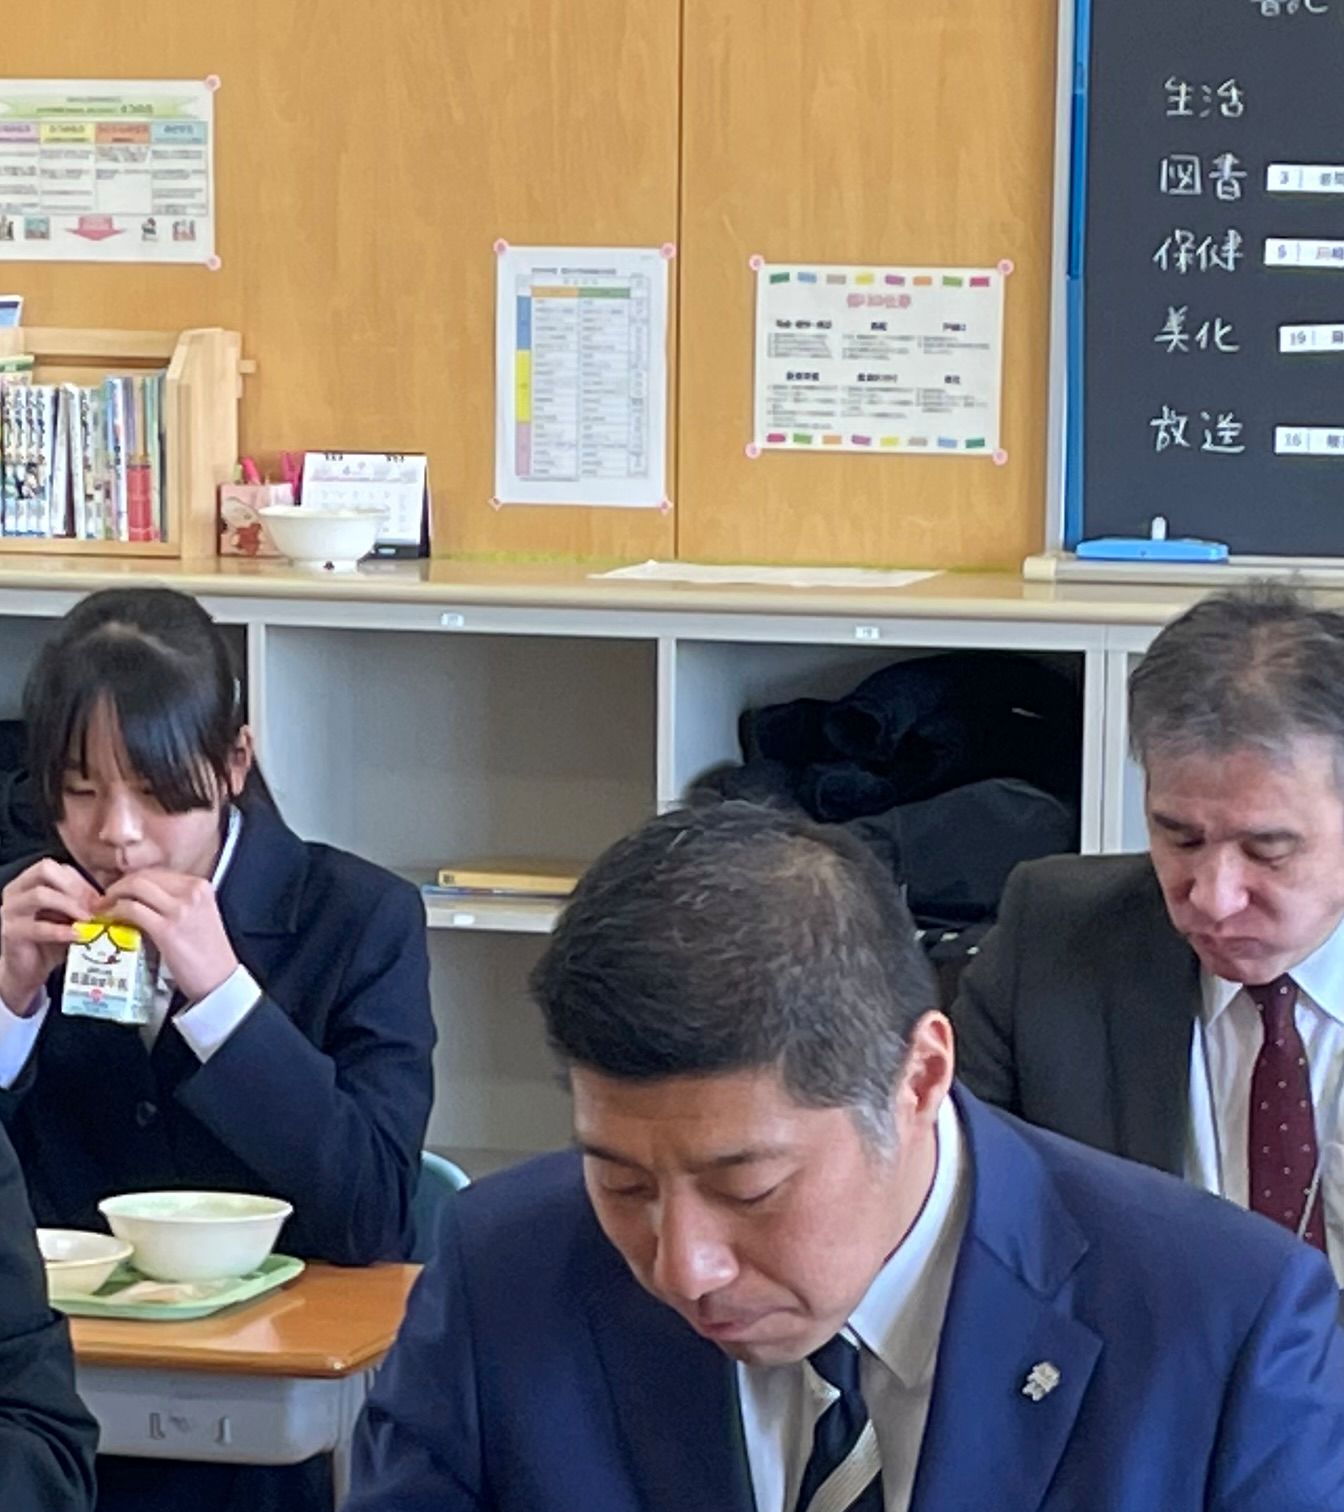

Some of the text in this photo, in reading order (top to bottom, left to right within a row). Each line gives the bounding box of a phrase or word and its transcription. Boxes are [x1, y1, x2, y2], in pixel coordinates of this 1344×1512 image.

[1164, 76, 1245, 118] 生活
[1160, 152, 1247, 201] 図書
[1152, 228, 1245, 274] 保健
[1154, 305, 1240, 353] 美化
[1150, 404, 1246, 454] 放送
